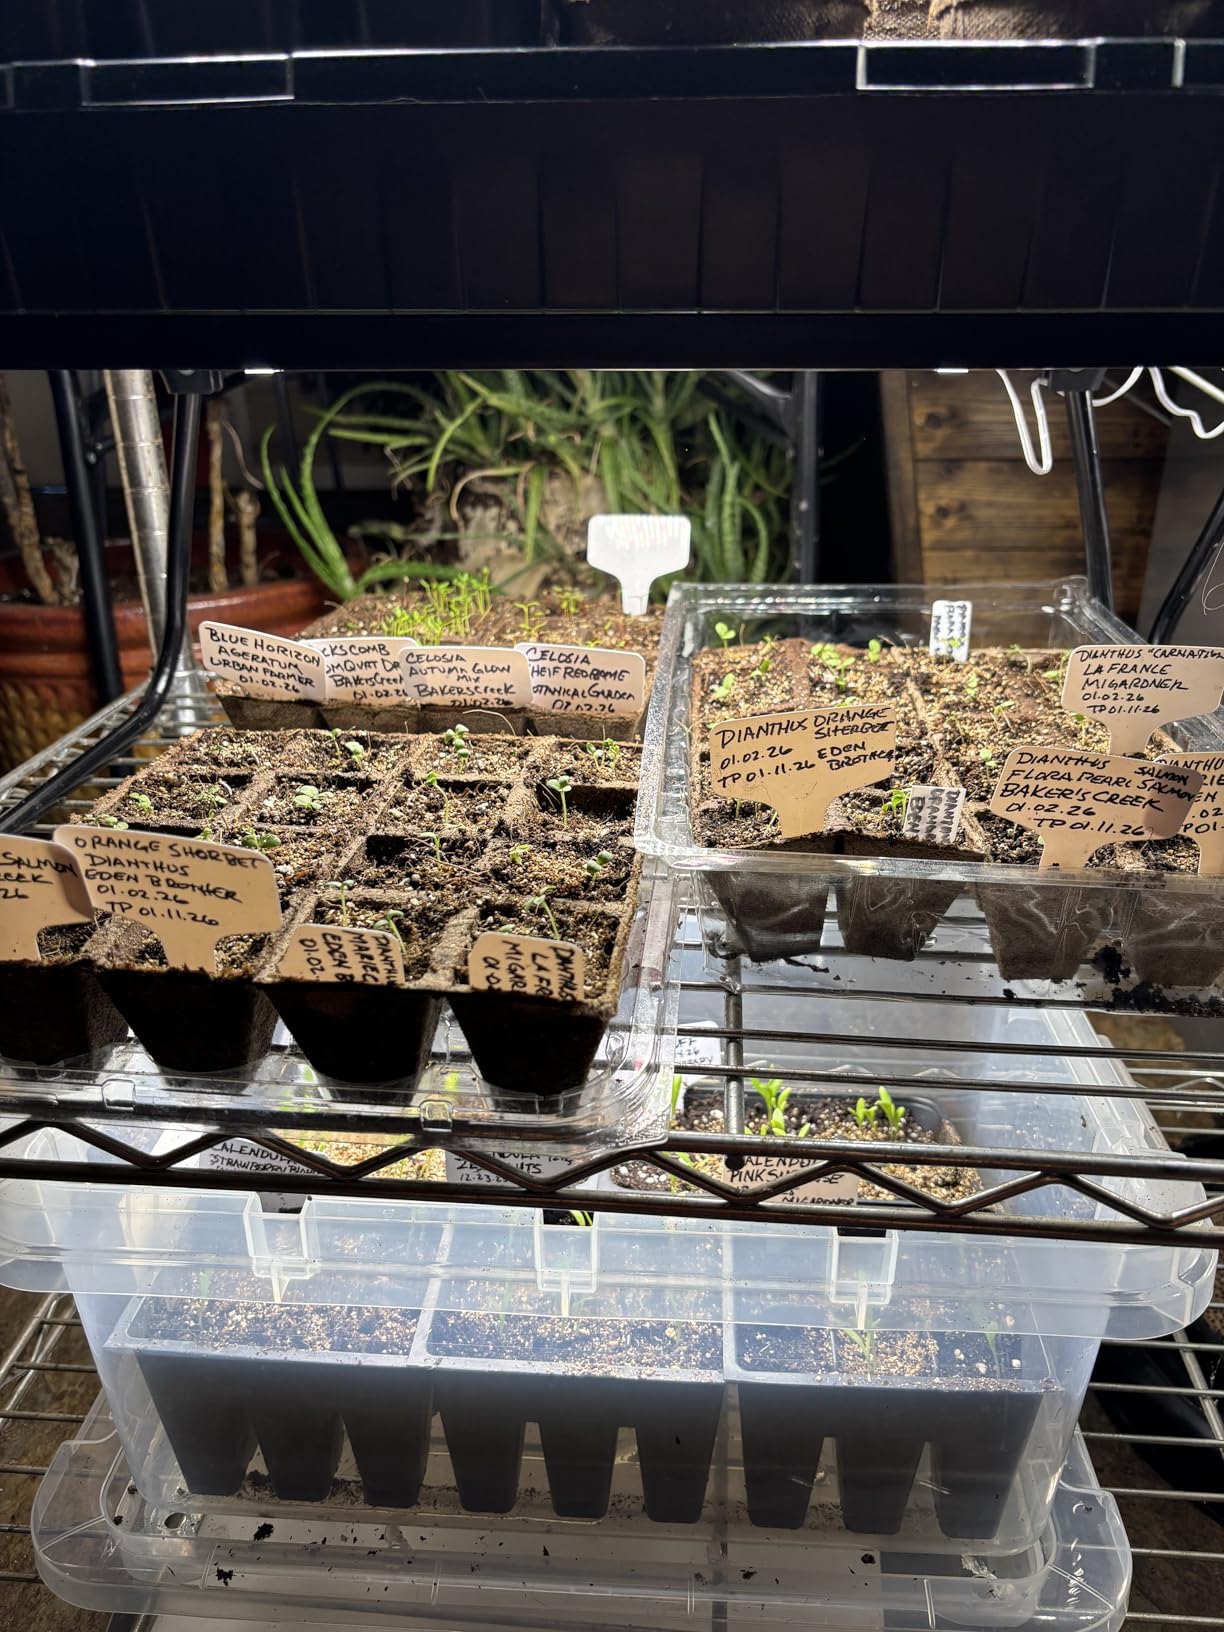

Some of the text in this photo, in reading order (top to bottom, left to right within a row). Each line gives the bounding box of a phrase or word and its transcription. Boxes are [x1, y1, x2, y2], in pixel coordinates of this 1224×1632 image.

[205, 627, 320, 667] BLUE HORIZON
[322, 644, 390, 656] CKSCOMB
[526, 647, 591, 665] CELOSIA
[1075, 649, 1143, 662] DIANTHUS
[218, 645, 303, 675] AGERATUM
[381, 658, 400, 672] DR
[406, 652, 466, 664] CELOSIA
[210, 657, 315, 688] URBAN FARMER
[472, 662, 511, 674] GLOW
[529, 664, 562, 678] HEIF
[1083, 663, 1173, 676] LA FRANCE
[240, 675, 300, 693] 01.02.26
[532, 684, 587, 699] OTANICAL
[1081, 678, 1189, 691] MIGARDNER
[1082, 691, 1145, 701] 01.02.26
[1087, 704, 1106, 714] TP
[715, 707, 891, 749] DIANTHUS ORANGE
[720, 741, 866, 770] 01.02.26 EDEN
[1016, 752, 1110, 770] DIANTHUS
[717, 759, 816, 789] TP 01.11.26
[1006, 768, 1074, 782] FLORA
[1076, 771, 1133, 788] PEARL
[1134, 765, 1190, 785] SALMON
[1005, 802, 1097, 818] 01.02.26
[1092, 791, 1164, 812] CREEK
[1032, 818, 1146, 836] TP 01.11.26
[75, 836, 269, 869] ORANGE SHORBET
[85, 853, 190, 876] DIANTHUS
[0, 873, 54, 884] EEK
[85, 869, 243, 903] EDEN BROTHER
[0, 888, 29, 899] 26
[97, 885, 189, 904] 01.02.26
[106, 901, 219, 926] TP 01.11.26
[299, 938, 326, 978] 01.02.
[502, 940, 527, 991] MIGAR
[533, 974, 553, 997] FR
[727, 1170, 765, 1182] PINK
